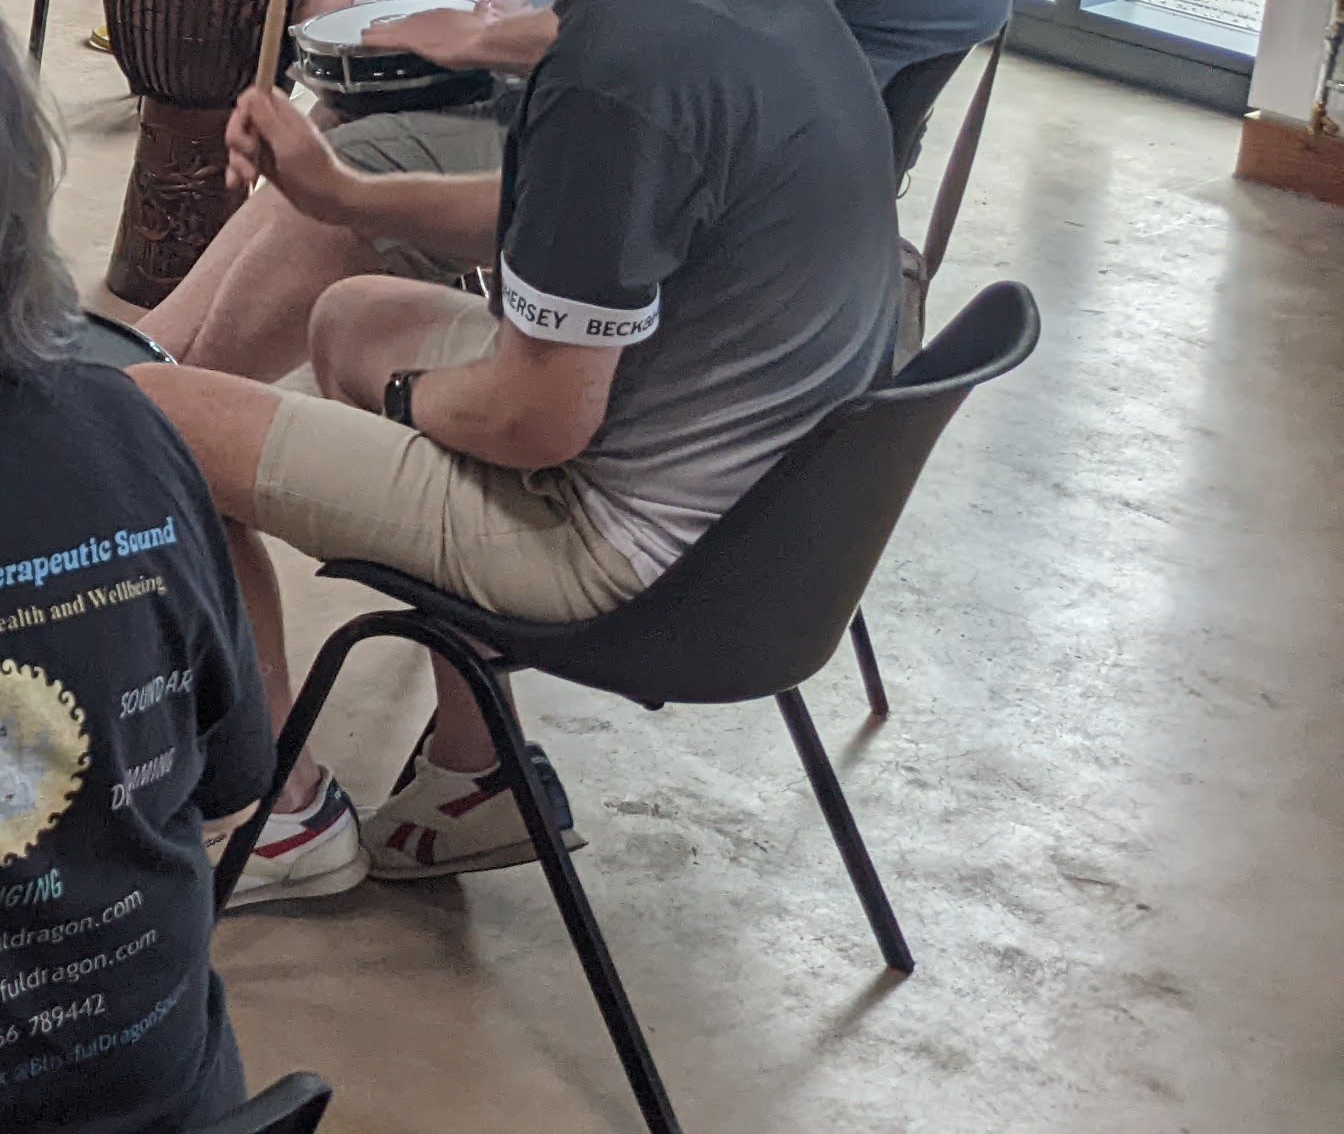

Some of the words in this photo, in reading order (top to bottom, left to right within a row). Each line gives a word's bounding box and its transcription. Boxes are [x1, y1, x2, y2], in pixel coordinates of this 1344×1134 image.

[114, 516, 177, 557] Sound
[50, 593, 86, 620] and
[87, 575, 167, 610] Wellbeing
[28, 993, 106, 1037] 789442
